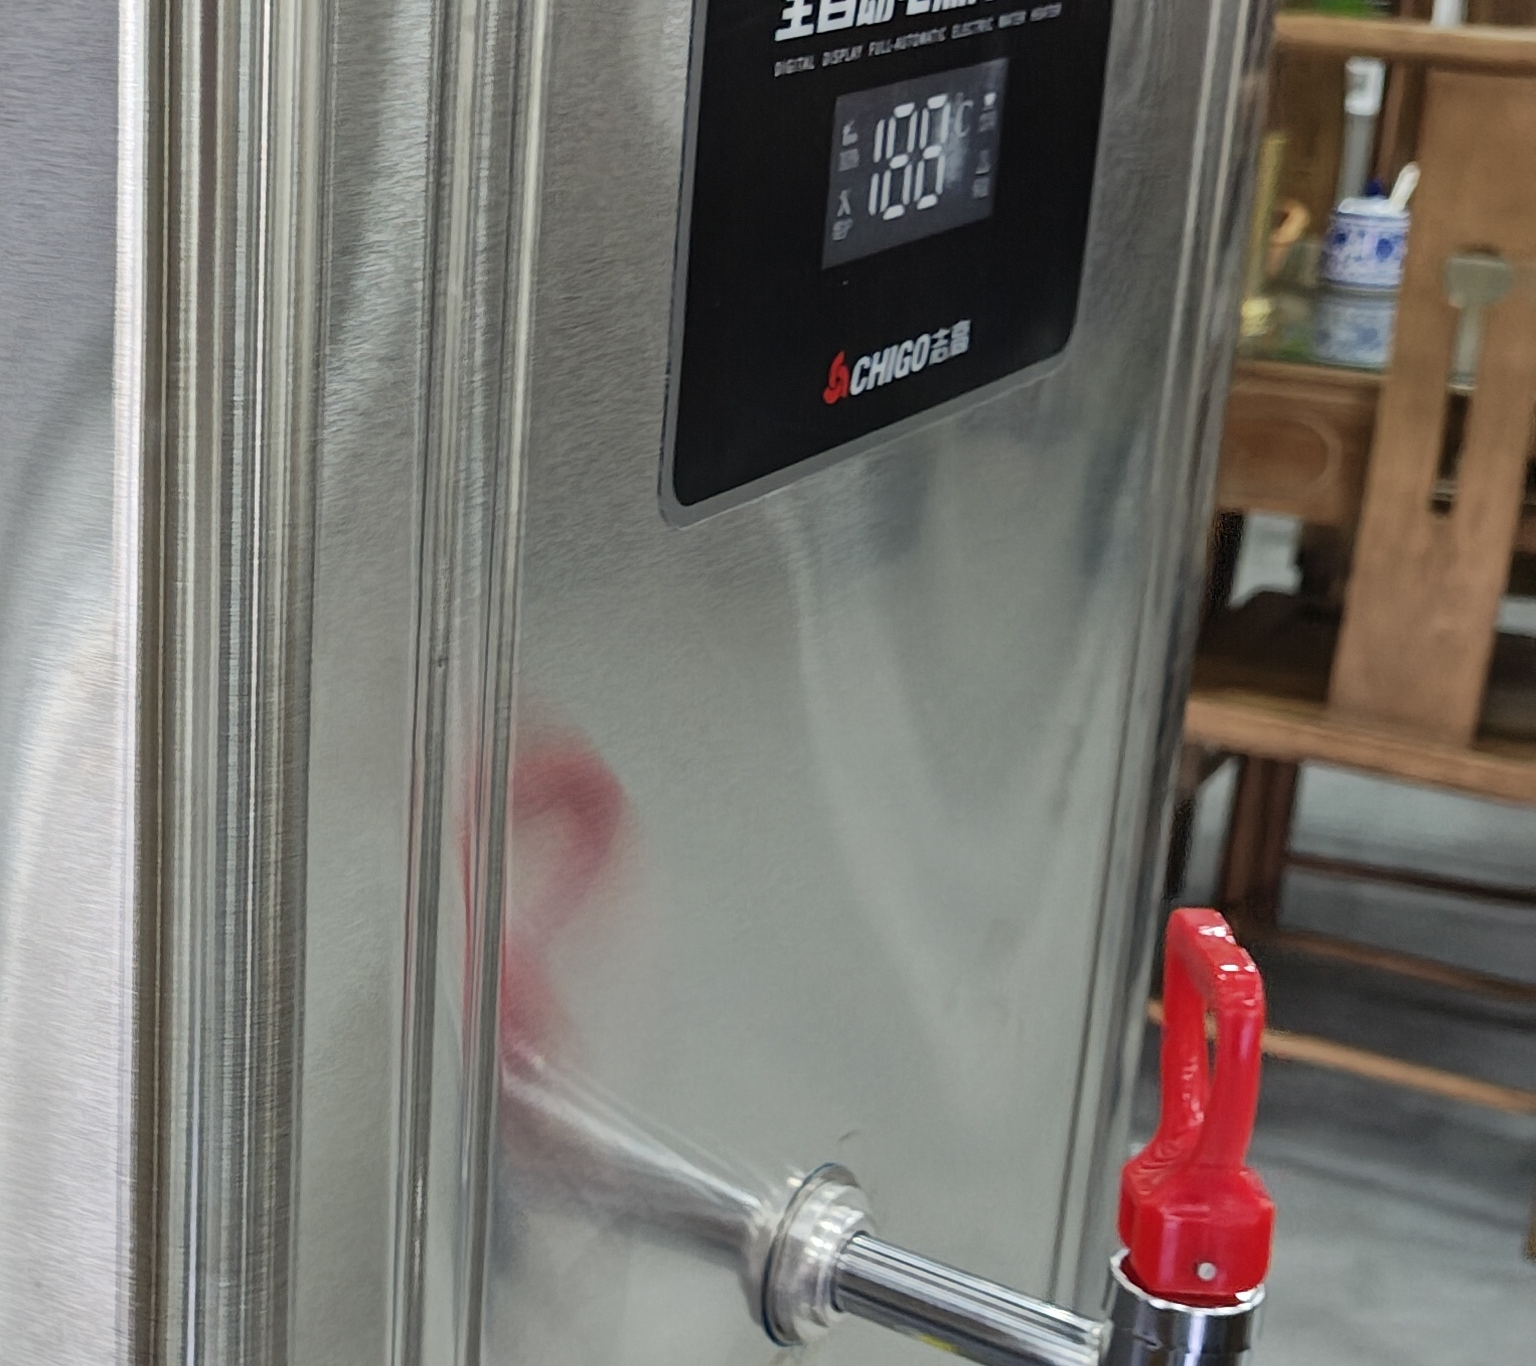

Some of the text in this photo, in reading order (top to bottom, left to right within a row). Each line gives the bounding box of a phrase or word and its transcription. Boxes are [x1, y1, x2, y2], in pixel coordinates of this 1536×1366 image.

[774, 56, 814, 77] DIGITAL
[822, 45, 863, 67] DISPLAY
[850, 333, 931, 396] CHIGO
